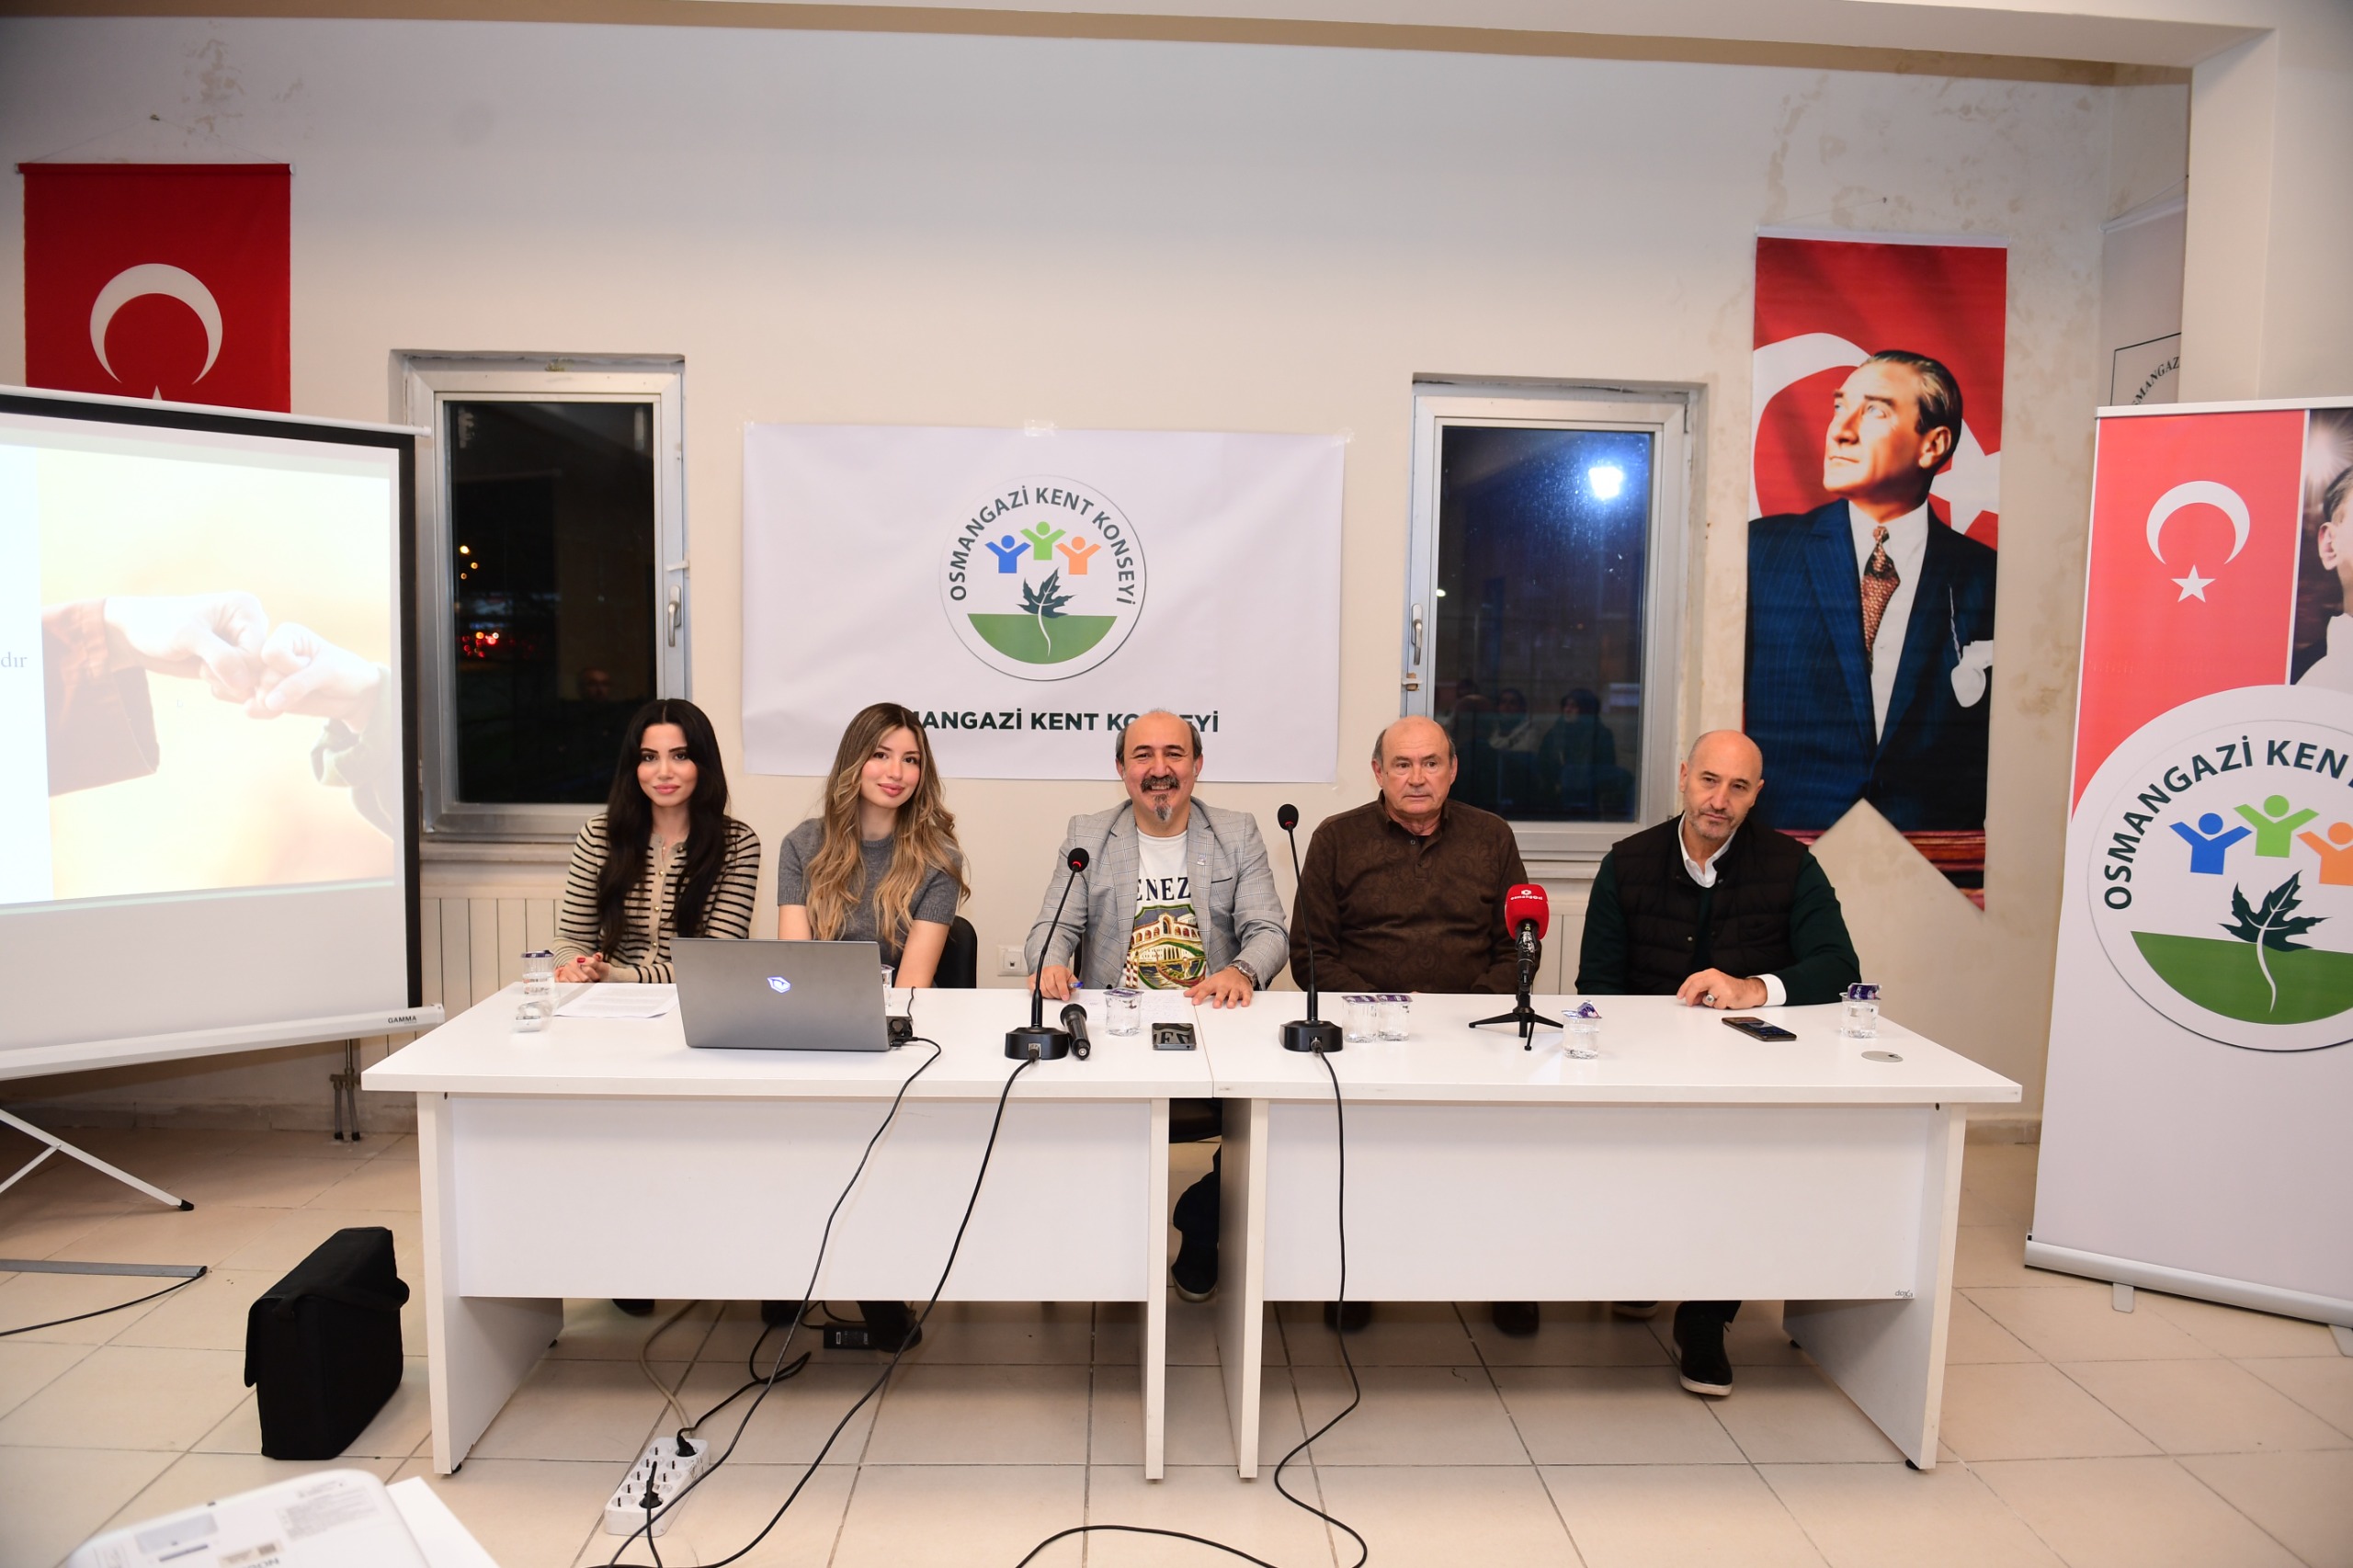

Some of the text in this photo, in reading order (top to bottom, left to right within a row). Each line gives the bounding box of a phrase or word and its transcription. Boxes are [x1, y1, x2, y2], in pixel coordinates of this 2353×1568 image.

[949, 485, 1136, 606] OSMANGAZİ KENT KONSEYİ
[1031, 712, 1099, 731] KENT
[2104, 735, 2353, 910] OSMANGAZİ KEN
[387, 1016, 417, 1024] GAMMA
